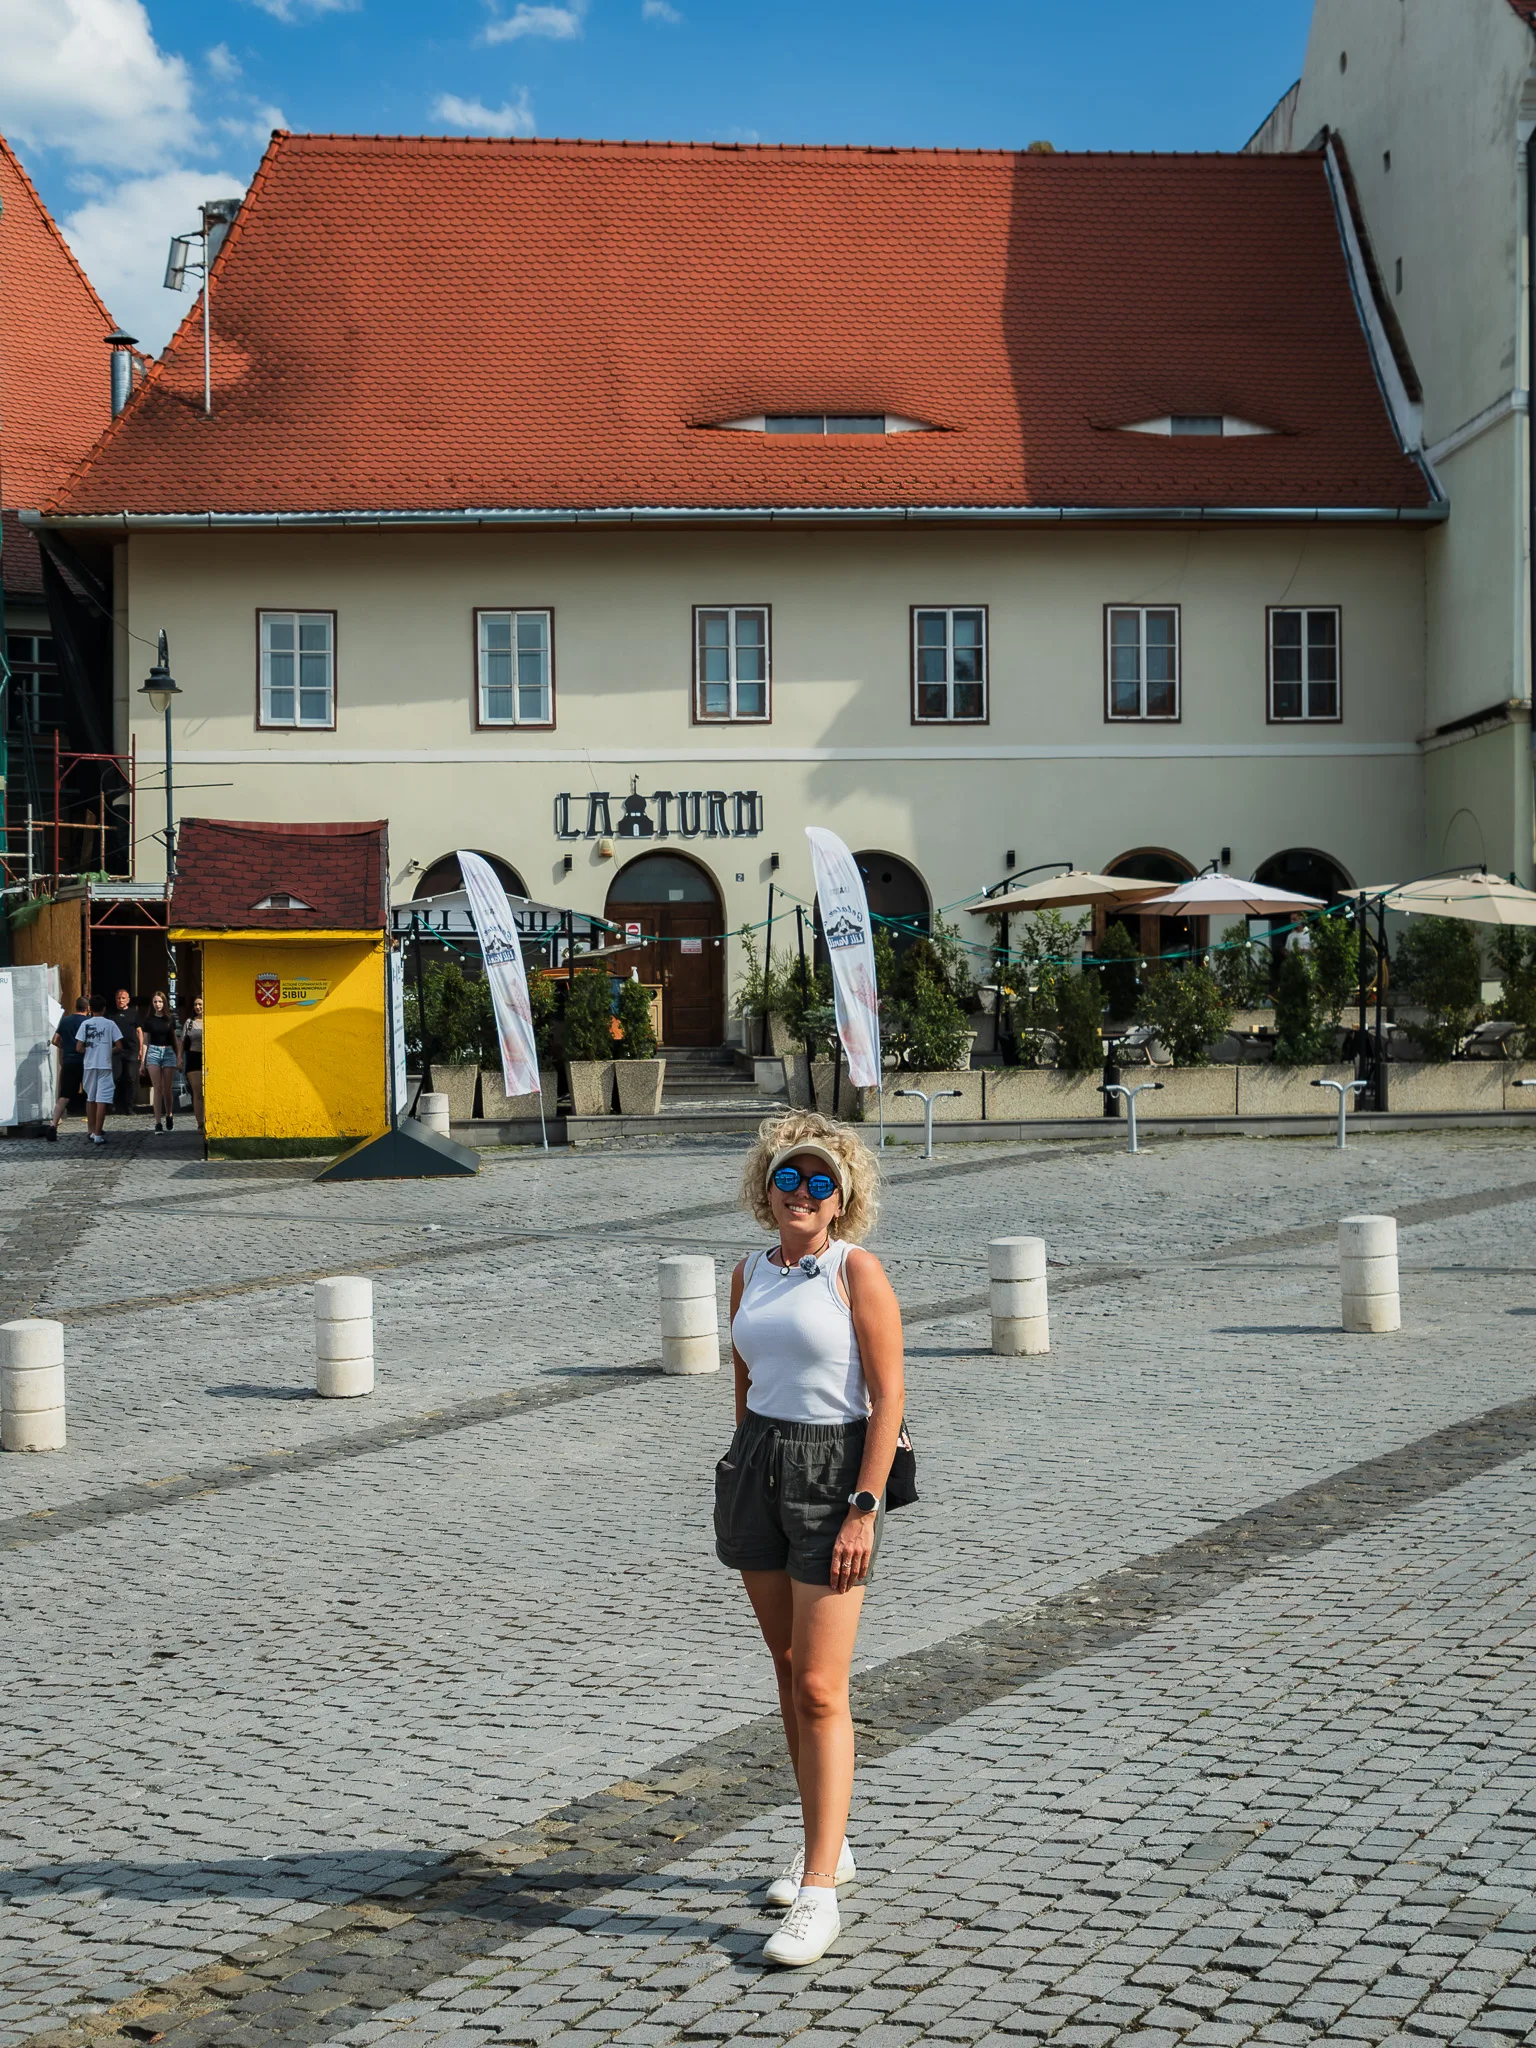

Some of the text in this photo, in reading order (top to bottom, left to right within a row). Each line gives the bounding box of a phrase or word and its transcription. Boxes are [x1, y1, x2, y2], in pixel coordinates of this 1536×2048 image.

[559, 790, 760, 839] LA TURN
[736, 873, 744, 882] 2
[282, 991, 307, 999] SIBIU
